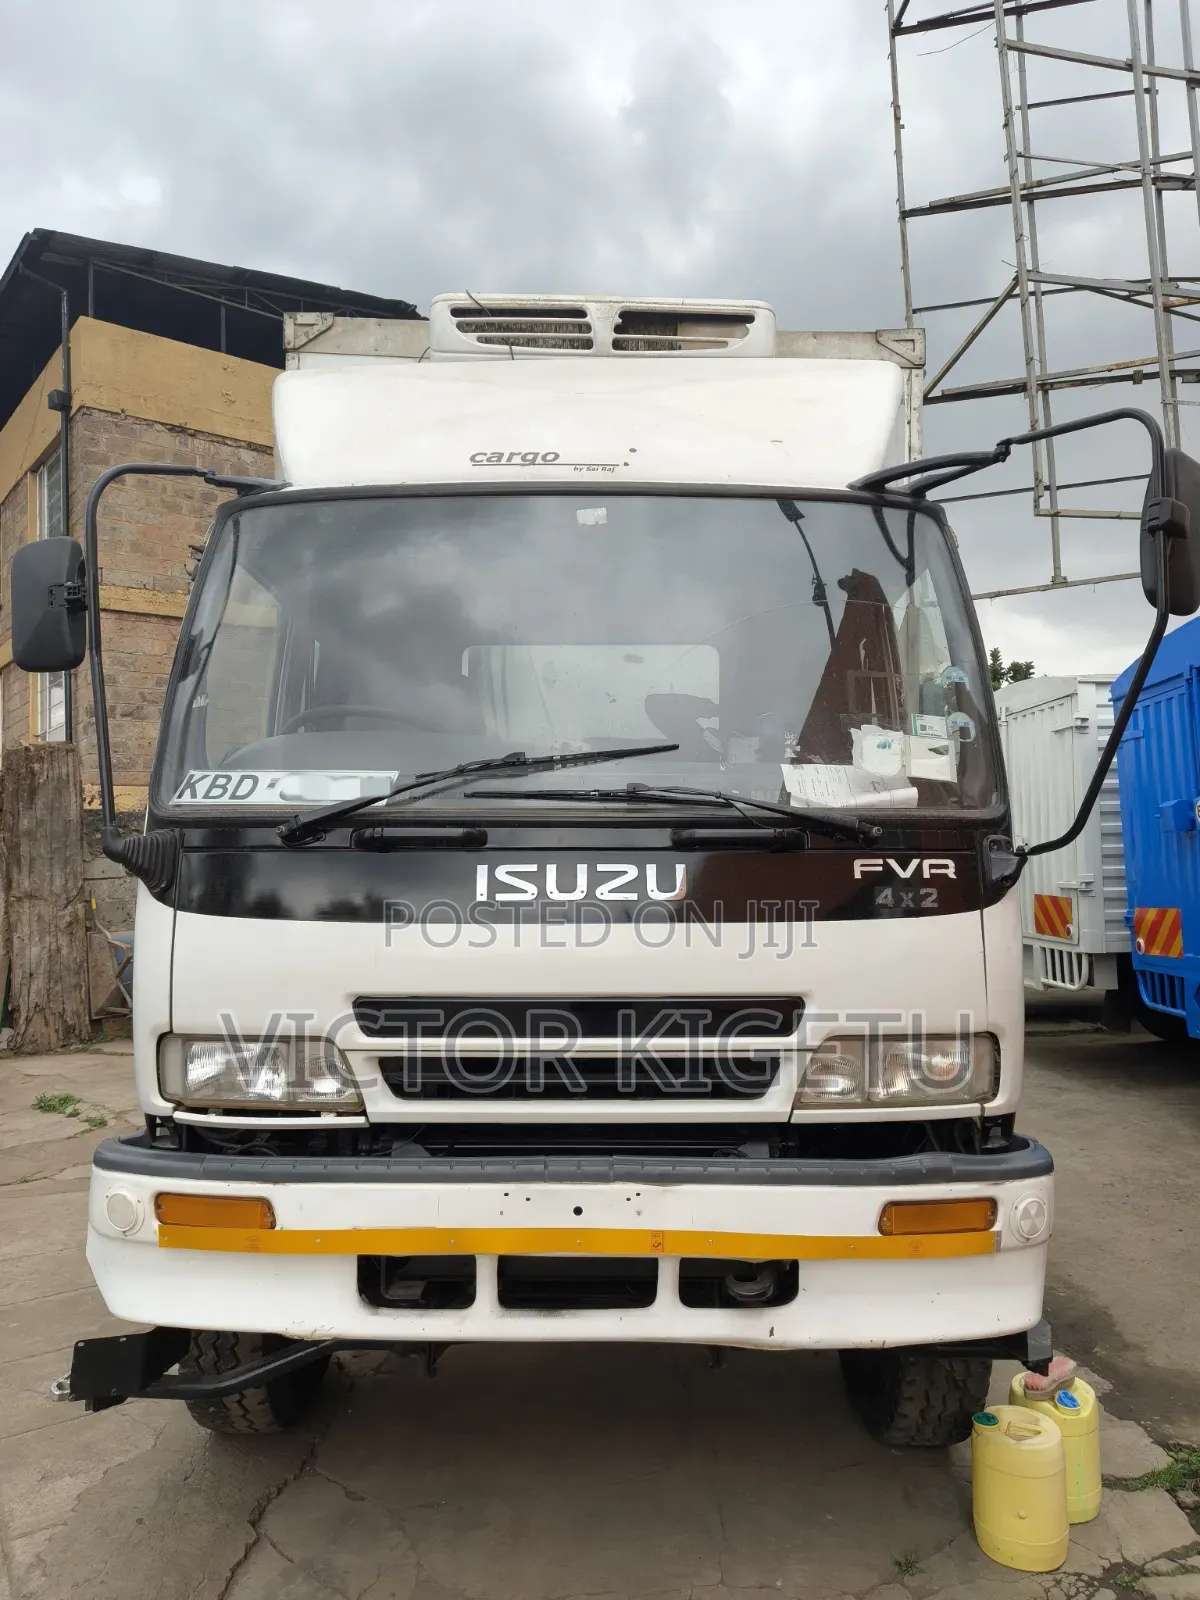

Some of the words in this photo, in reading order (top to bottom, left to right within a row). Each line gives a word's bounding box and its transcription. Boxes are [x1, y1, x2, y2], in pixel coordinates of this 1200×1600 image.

[469, 451, 560, 467] cargo
[176, 773, 260, 800] KBD
[853, 858, 957, 879] FVR
[475, 863, 687, 902] ISUZU
